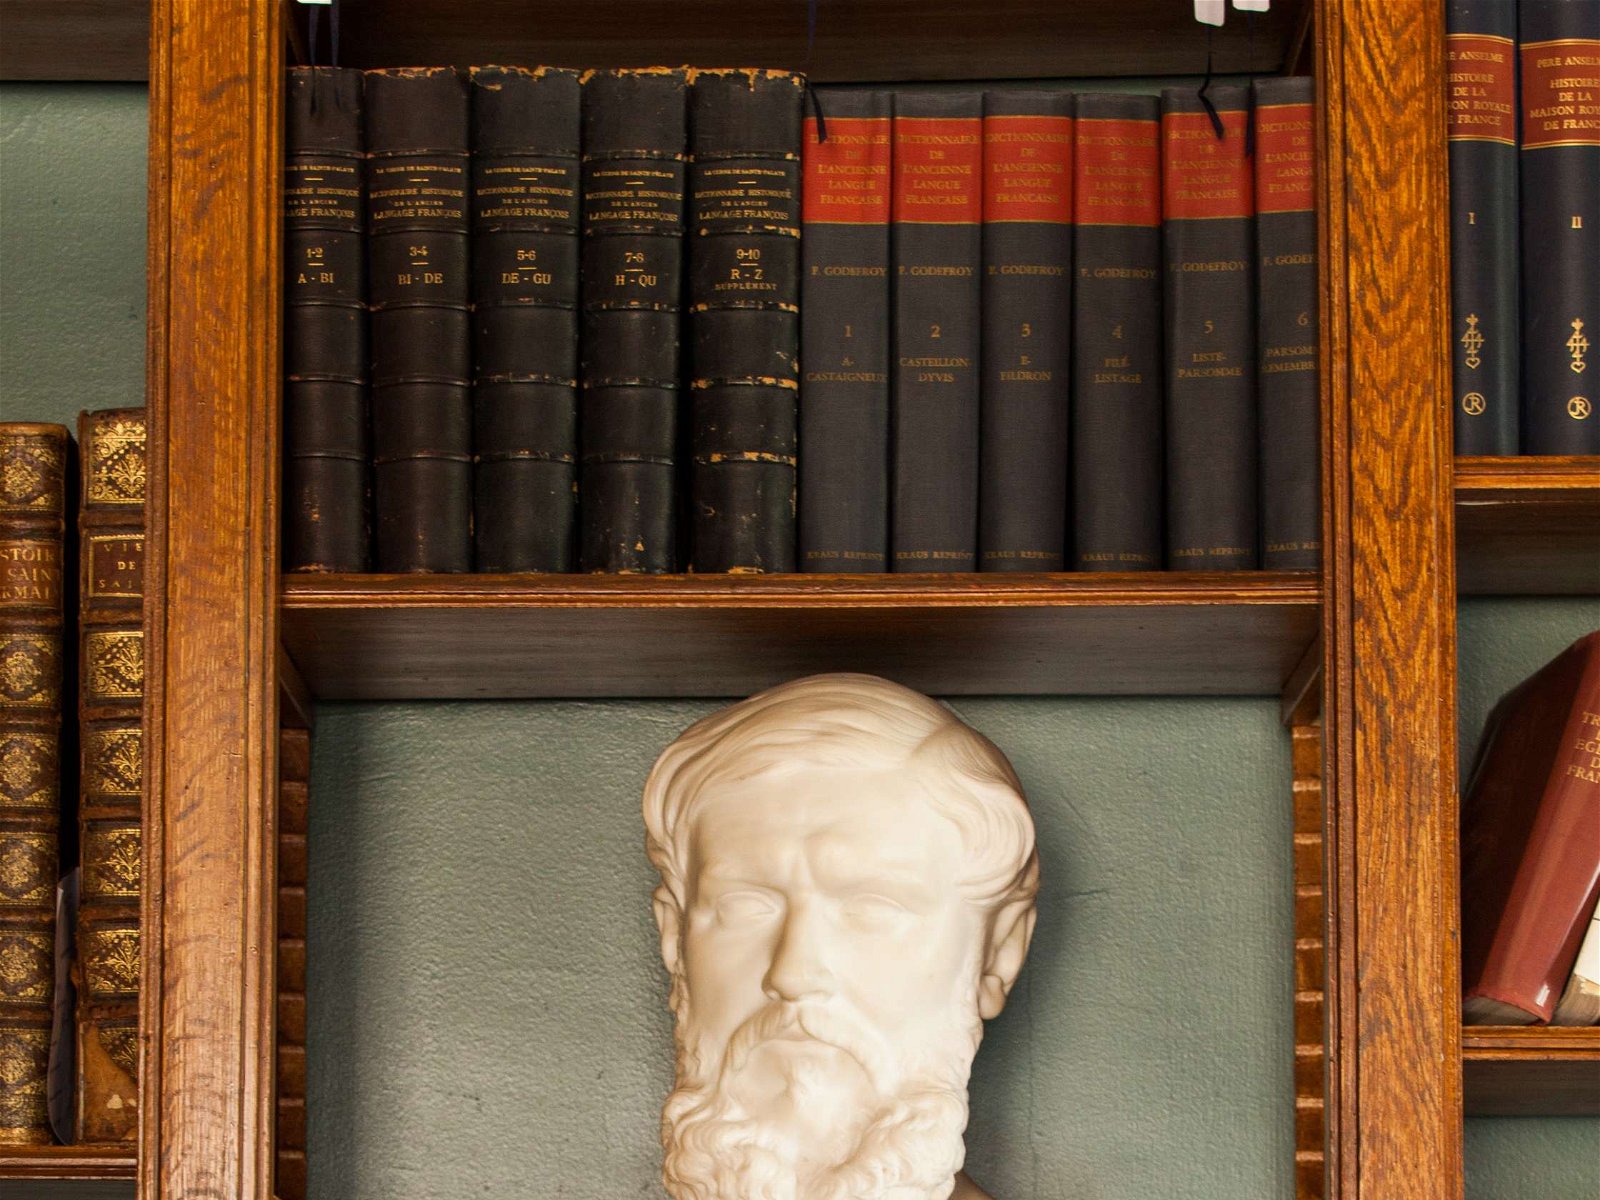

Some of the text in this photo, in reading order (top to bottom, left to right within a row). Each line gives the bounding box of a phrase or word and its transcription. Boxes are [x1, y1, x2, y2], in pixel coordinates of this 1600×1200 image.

[1459, 51, 1504, 63] ANSELME
[1453, 87, 1487, 97] DE LA
[1559, 91, 1593, 102] DE LA
[1530, 105, 1575, 118] MAISON
[1457, 114, 1502, 126] FRANCE
[1544, 120, 1560, 131] DE
[517, 250, 537, 261] 5-6
[736, 249, 760, 260] 9-10
[730, 268, 764, 280] R Z
[824, 266, 888, 277] GODEFROY
[911, 266, 974, 277] GODEFROY
[1000, 265, 1064, 276] GODEFROY
[297, 272, 335, 284] A BI
[398, 273, 444, 285] BI DE
[502, 273, 552, 285] DE GU
[615, 275, 657, 288] H QU
[1296, 311, 1309, 326] 6
[930, 324, 941, 338] 2
[1021, 323, 1032, 338] 3
[1111, 325, 1122, 339] 4
[1204, 320, 1214, 334] 5
[918, 373, 955, 383] DYVIS
[117, 561, 137, 571] DE
